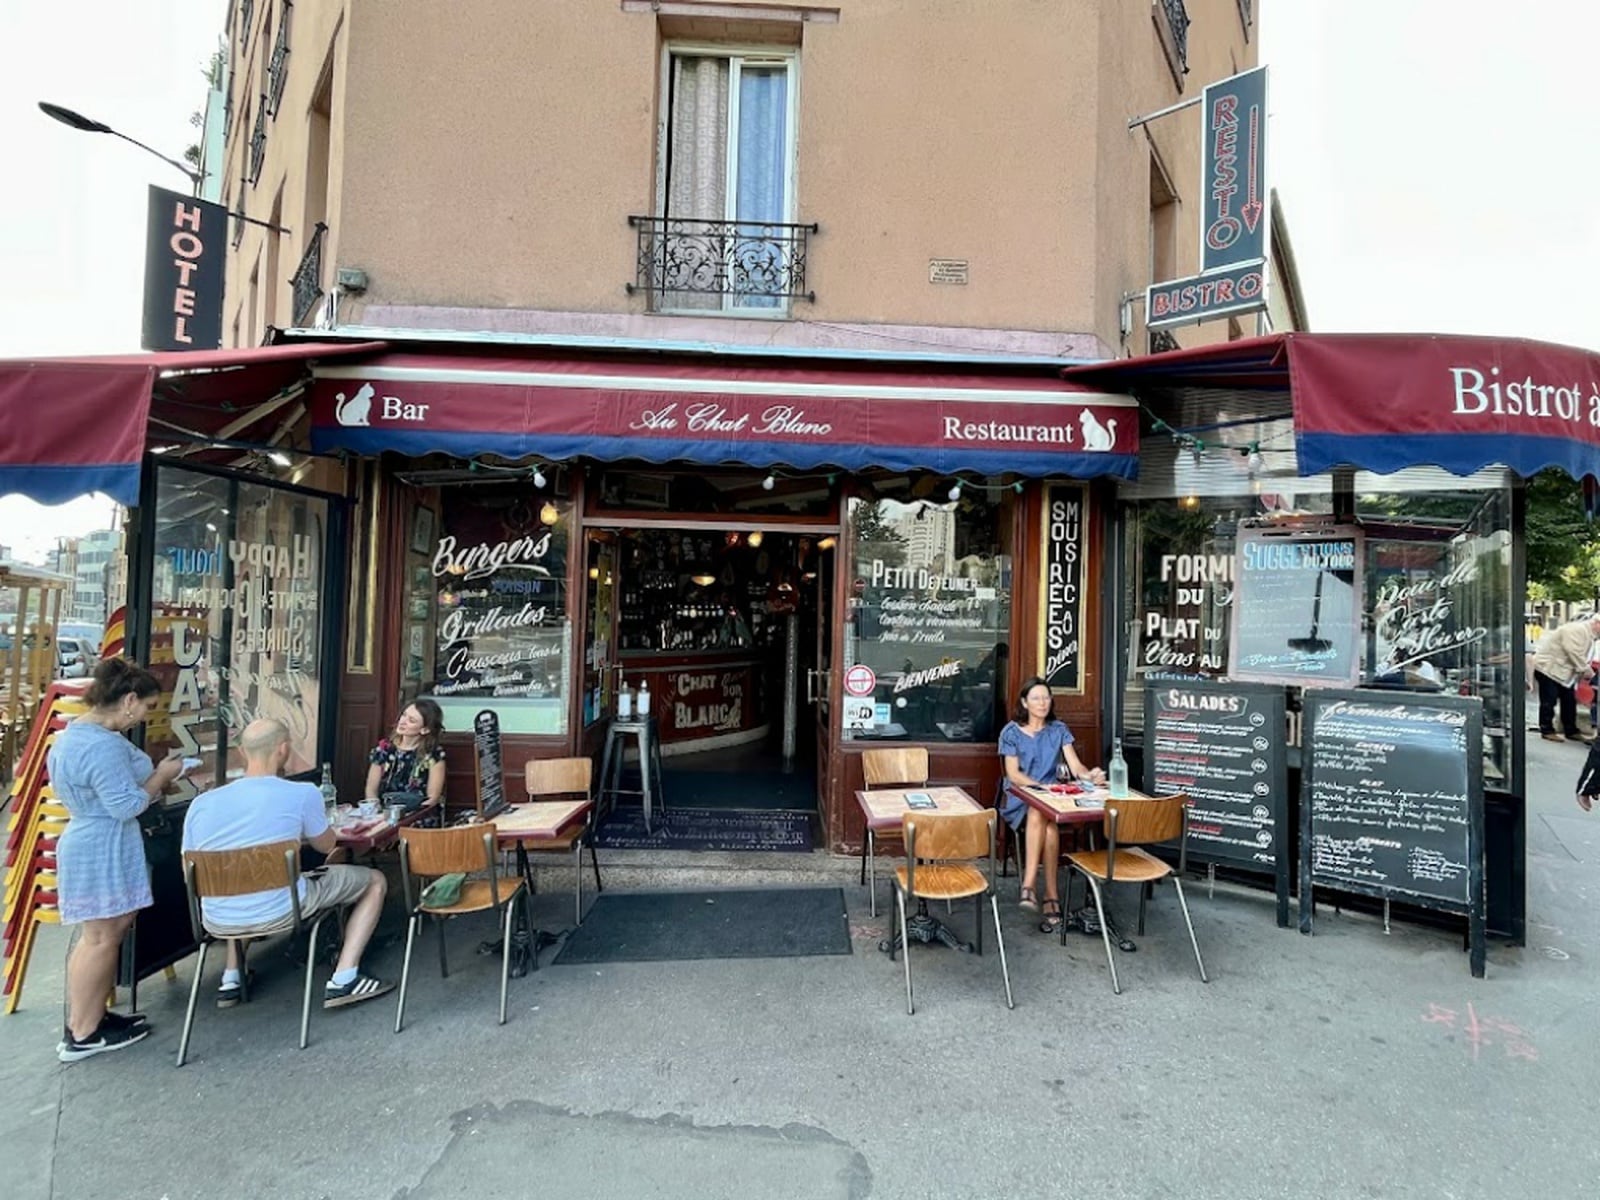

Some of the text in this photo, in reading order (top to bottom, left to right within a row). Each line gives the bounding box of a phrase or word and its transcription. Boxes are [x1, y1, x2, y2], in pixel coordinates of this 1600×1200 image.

[1206, 94, 1242, 250] RESTO
[170, 202, 203, 344] HOTEL
[1152, 272, 1264, 316] BISTRO
[1448, 366, 1581, 422] Bistrot
[381, 397, 429, 421] Bar
[629, 402, 832, 436] Au Chat Blanc
[943, 416, 1074, 443] Restaurant
[432, 533, 552, 581] Burgers
[1243, 541, 1354, 570] SUGGESTIONS
[871, 559, 915, 589] PETIT
[1177, 588, 1205, 606] DU
[440, 602, 547, 650] Grillades
[1146, 612, 1222, 641] PLAT DU
[446, 647, 522, 678] Couscous
[1144, 640, 1222, 669] Vins AU
[678, 673, 717, 696] CHAT
[893, 659, 962, 693] BIENVENUE
[675, 702, 728, 728] BLANC
[1169, 689, 1240, 712] SALADES
[1321, 701, 1408, 720] Formules
